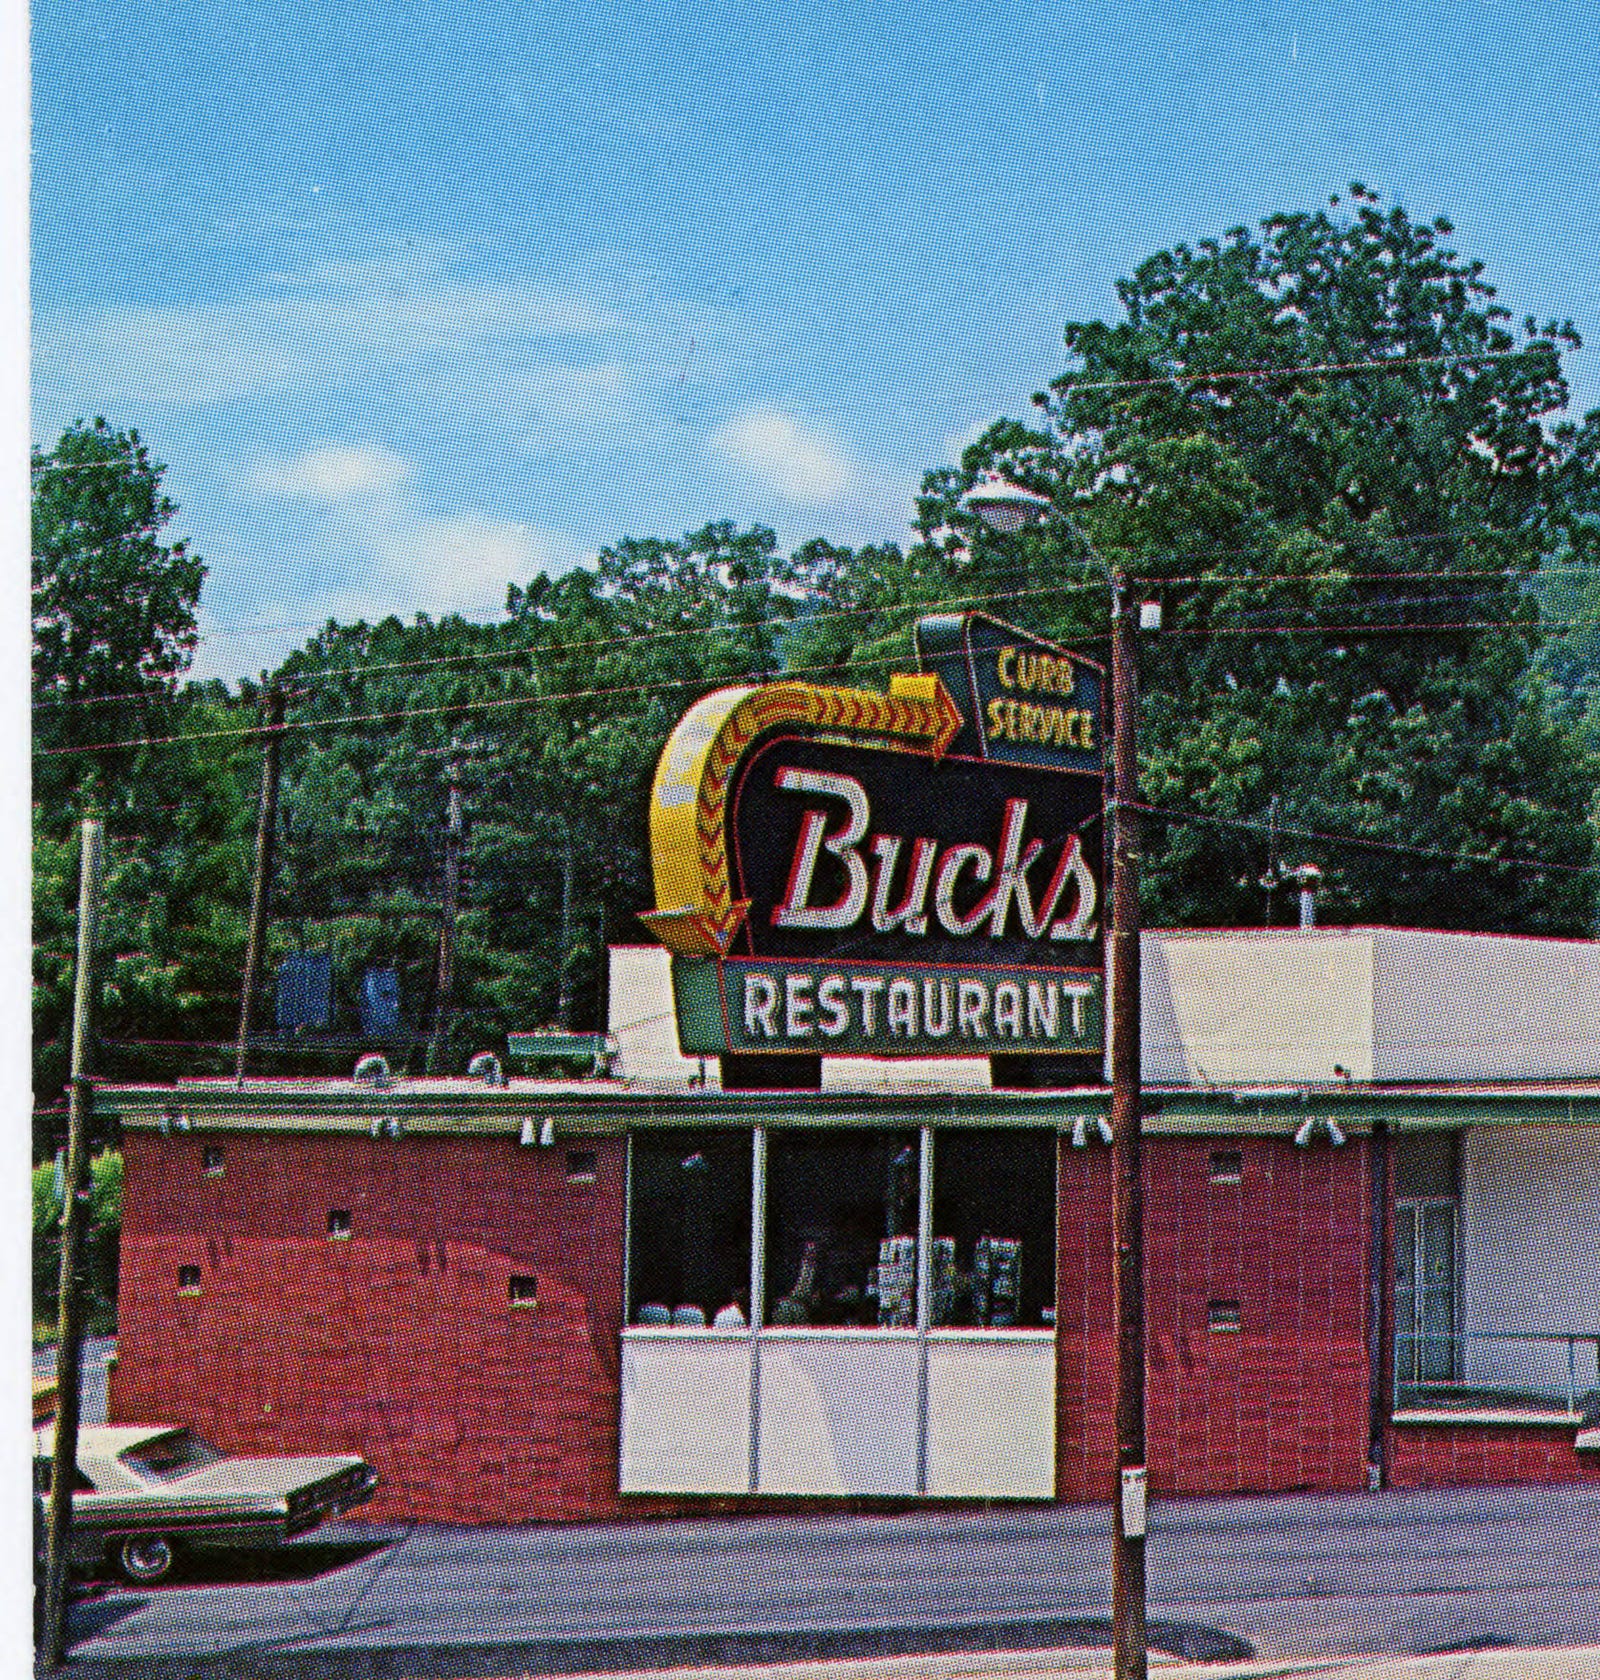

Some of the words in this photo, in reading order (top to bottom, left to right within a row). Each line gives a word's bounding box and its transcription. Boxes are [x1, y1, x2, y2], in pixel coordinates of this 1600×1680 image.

[997, 646, 1075, 694] CURB
[987, 698, 1095, 750] SERVICE
[771, 765, 1098, 941] Bucks
[743, 973, 1095, 1038] RESTAURANT
